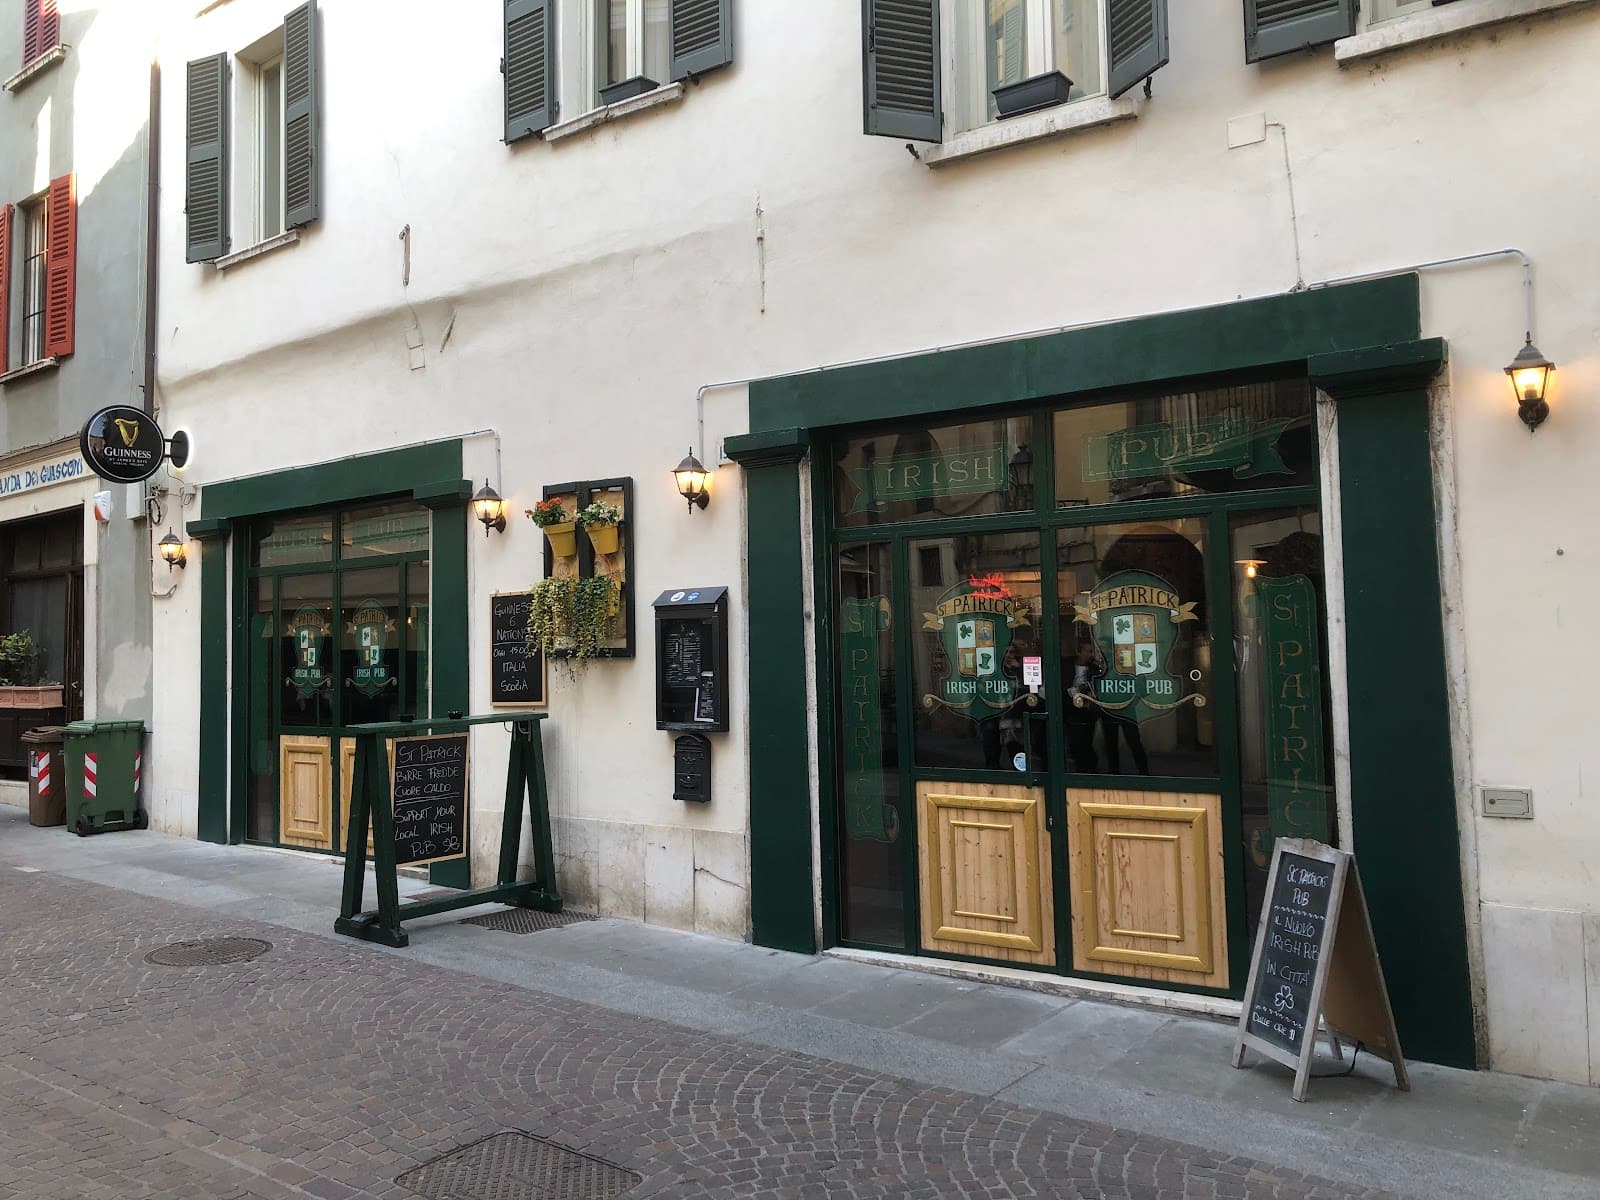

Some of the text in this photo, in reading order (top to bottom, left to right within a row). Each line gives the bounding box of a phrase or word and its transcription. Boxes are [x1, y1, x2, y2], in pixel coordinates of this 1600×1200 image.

[104, 446, 152, 459] GUINNESS
[886, 431, 1214, 489] IRISH PUB
[953, 595, 1012, 617] PATRICK
[1108, 586, 1176, 609] PATRICK
[509, 616, 516, 627] 6
[373, 667, 386, 678] PUB
[502, 661, 527, 673] ITALIA
[500, 679, 529, 692] SCOZIA
[946, 680, 1009, 694] IRISH PUB
[1100, 679, 1173, 694] IRISH PUB
[1277, 639, 1311, 836] PATRIC
[420, 744, 462, 761] PATRICK
[427, 766, 460, 780] FREDDE
[423, 783, 452, 794] CALDO
[433, 804, 456, 821] YOUR
[394, 822, 453, 841] LOCAL IRISH
[1292, 887, 1310, 906] PUB
[1284, 916, 1315, 937] NUOVO
[1266, 959, 1277, 976] IN
